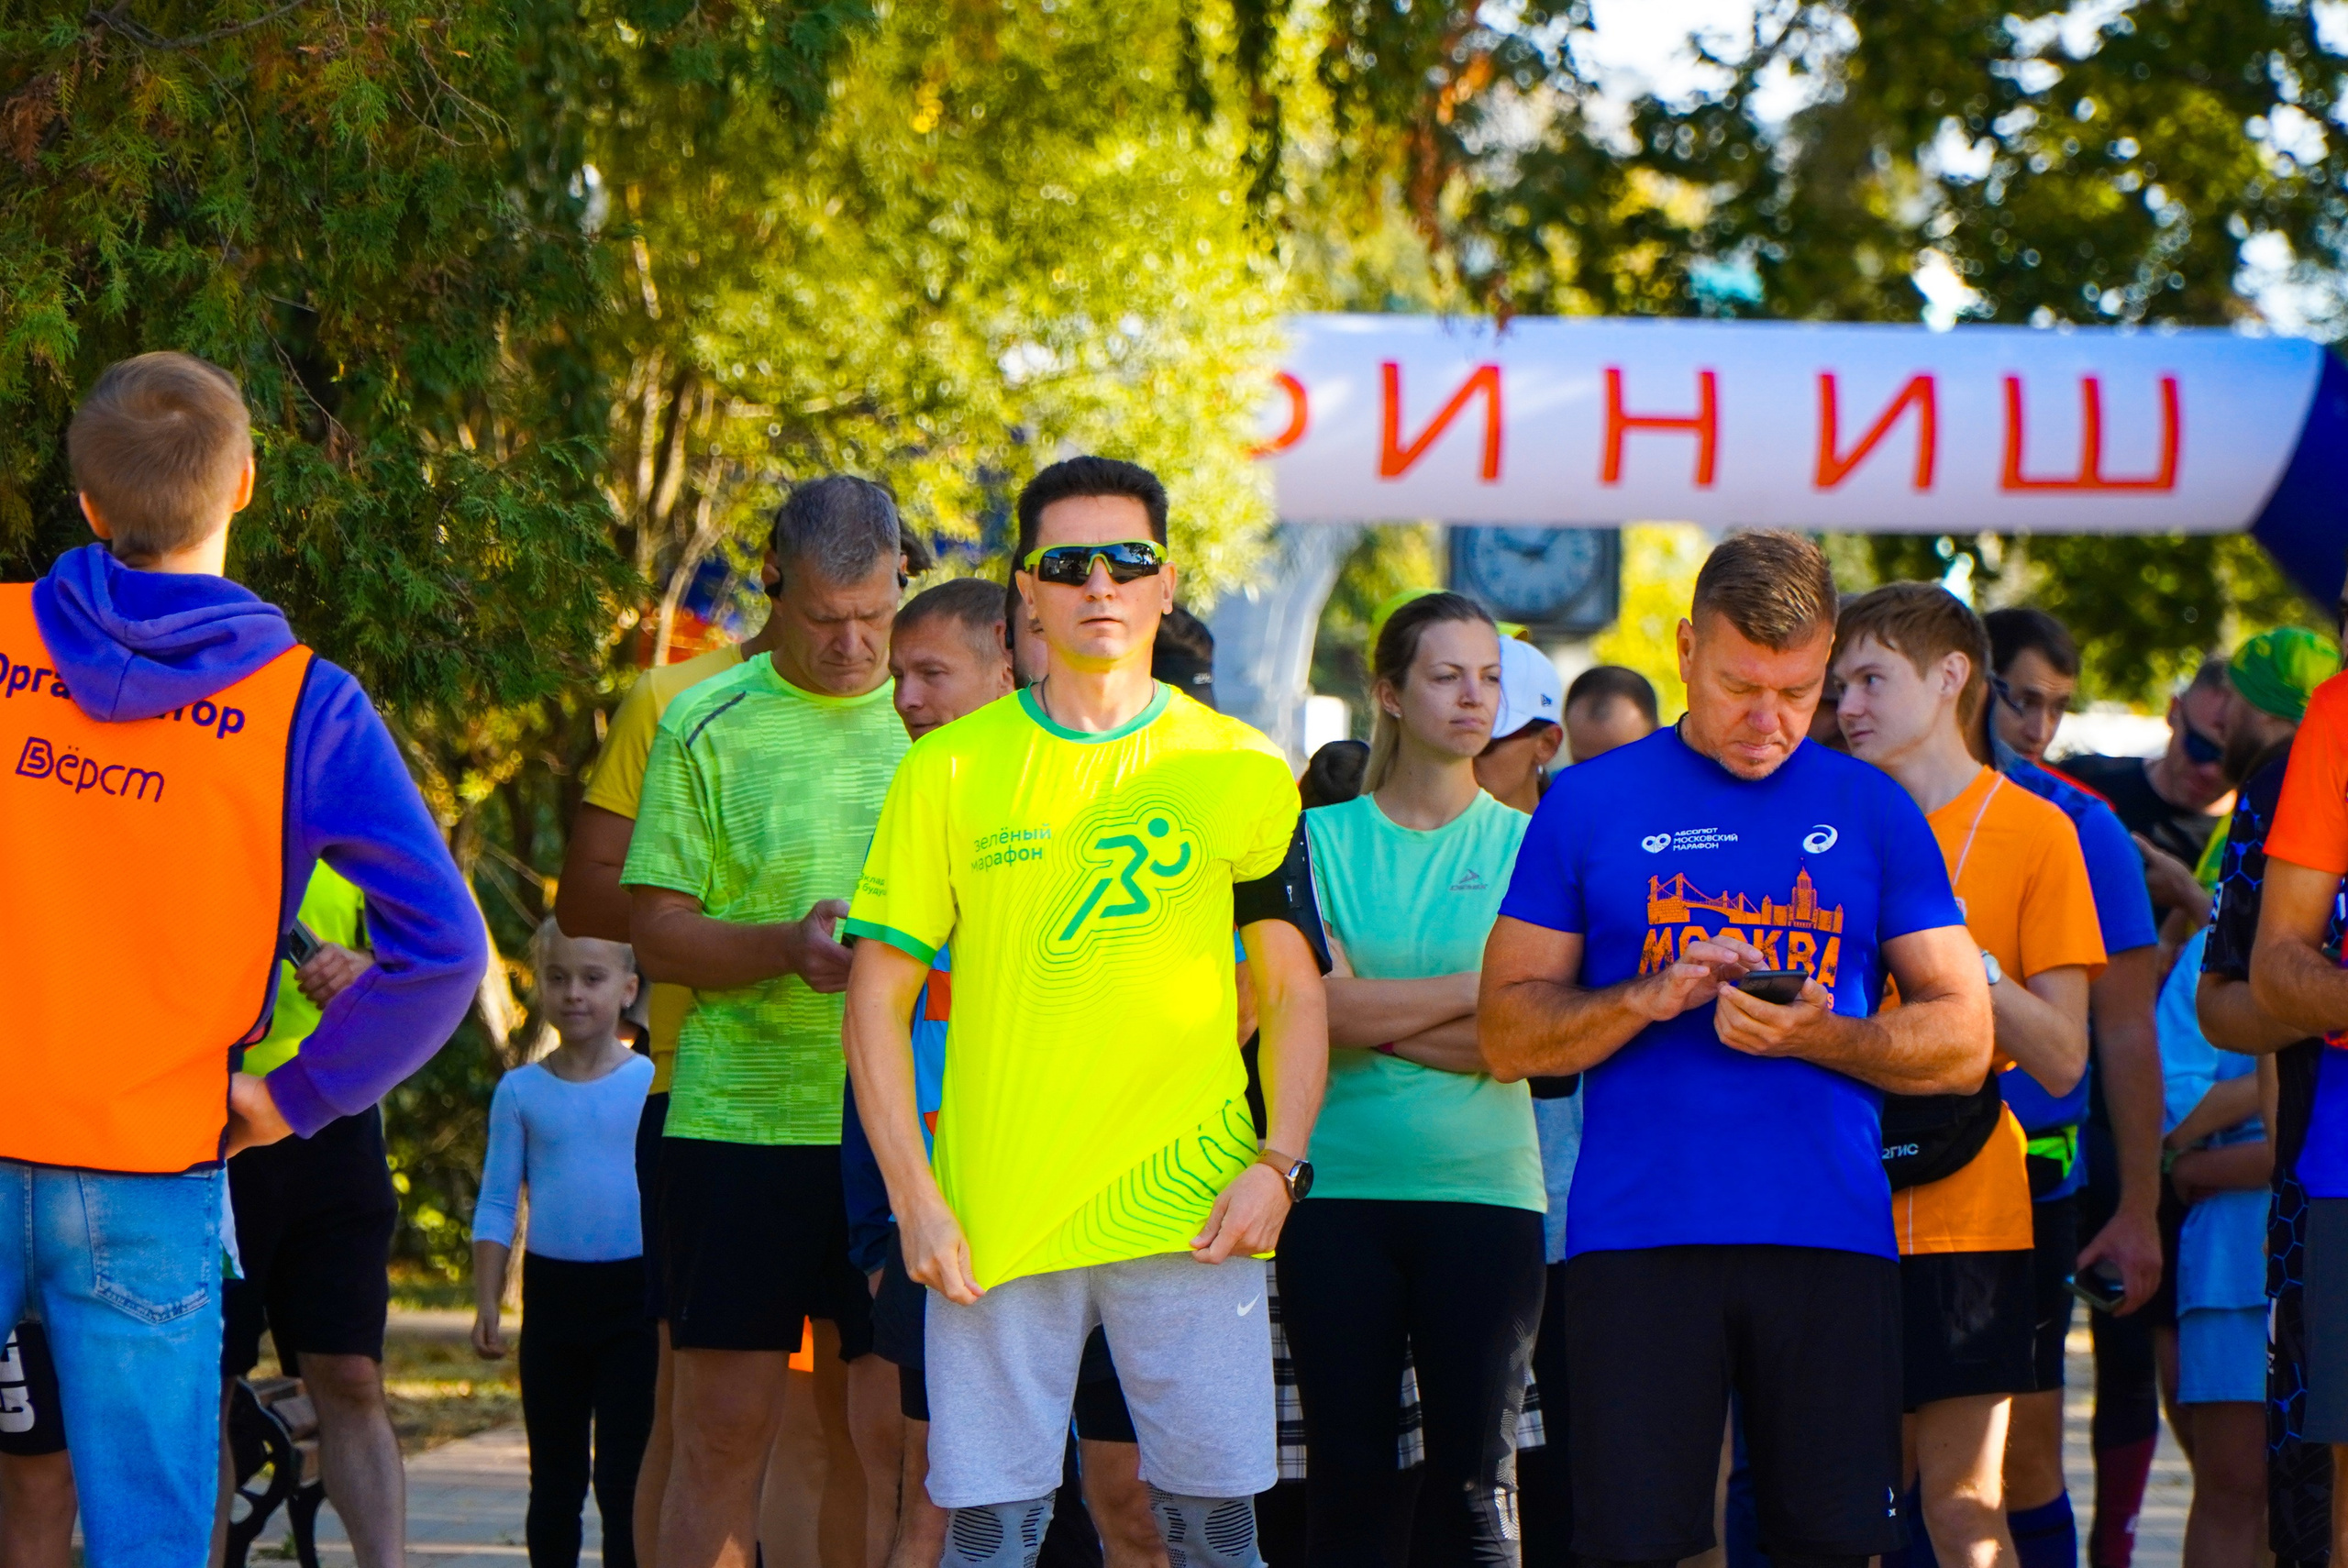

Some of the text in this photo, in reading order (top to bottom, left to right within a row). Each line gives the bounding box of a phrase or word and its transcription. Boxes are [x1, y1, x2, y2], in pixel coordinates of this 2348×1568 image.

[1674, 827, 1718, 836] АБСОЛЮТ
[974, 823, 1052, 853] зелёный
[1673, 834, 1738, 844] МОСКОВСКИЙ
[1673, 843, 1719, 851] МАРАФОН
[970, 845, 1043, 873] марафон
